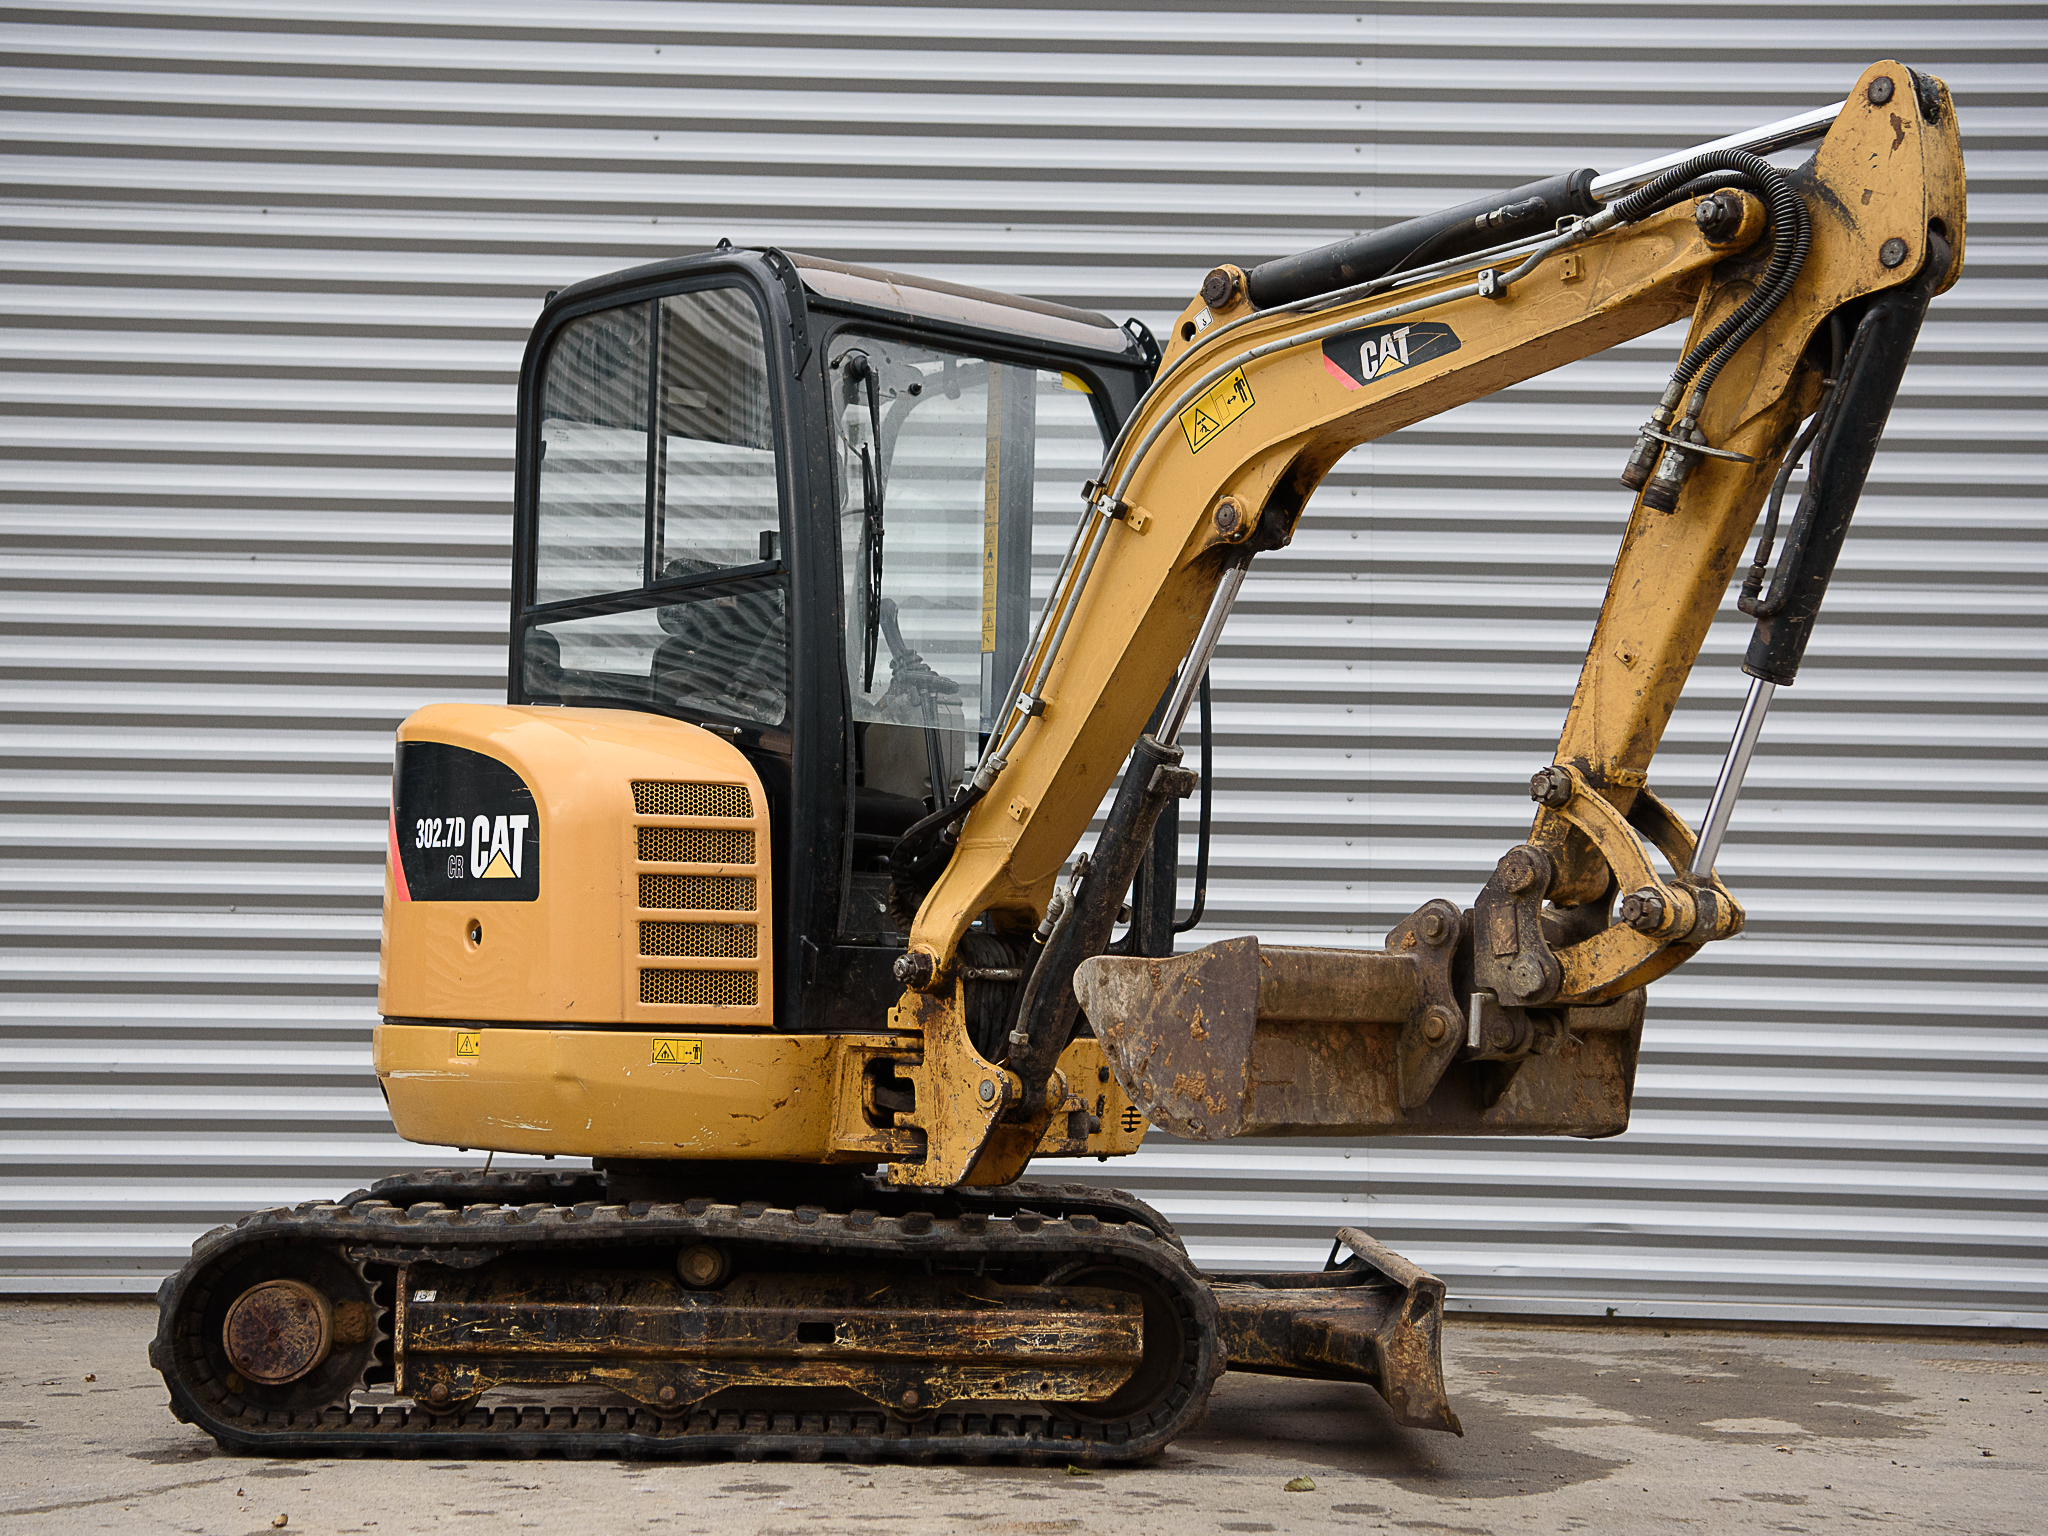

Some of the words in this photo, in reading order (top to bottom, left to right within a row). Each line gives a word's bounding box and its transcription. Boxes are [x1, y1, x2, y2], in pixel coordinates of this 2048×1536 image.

[1360, 325, 1410, 380] CAT
[415, 816, 466, 849] 302.7D
[470, 814, 529, 879] CAT
[447, 854, 464, 879] CR
